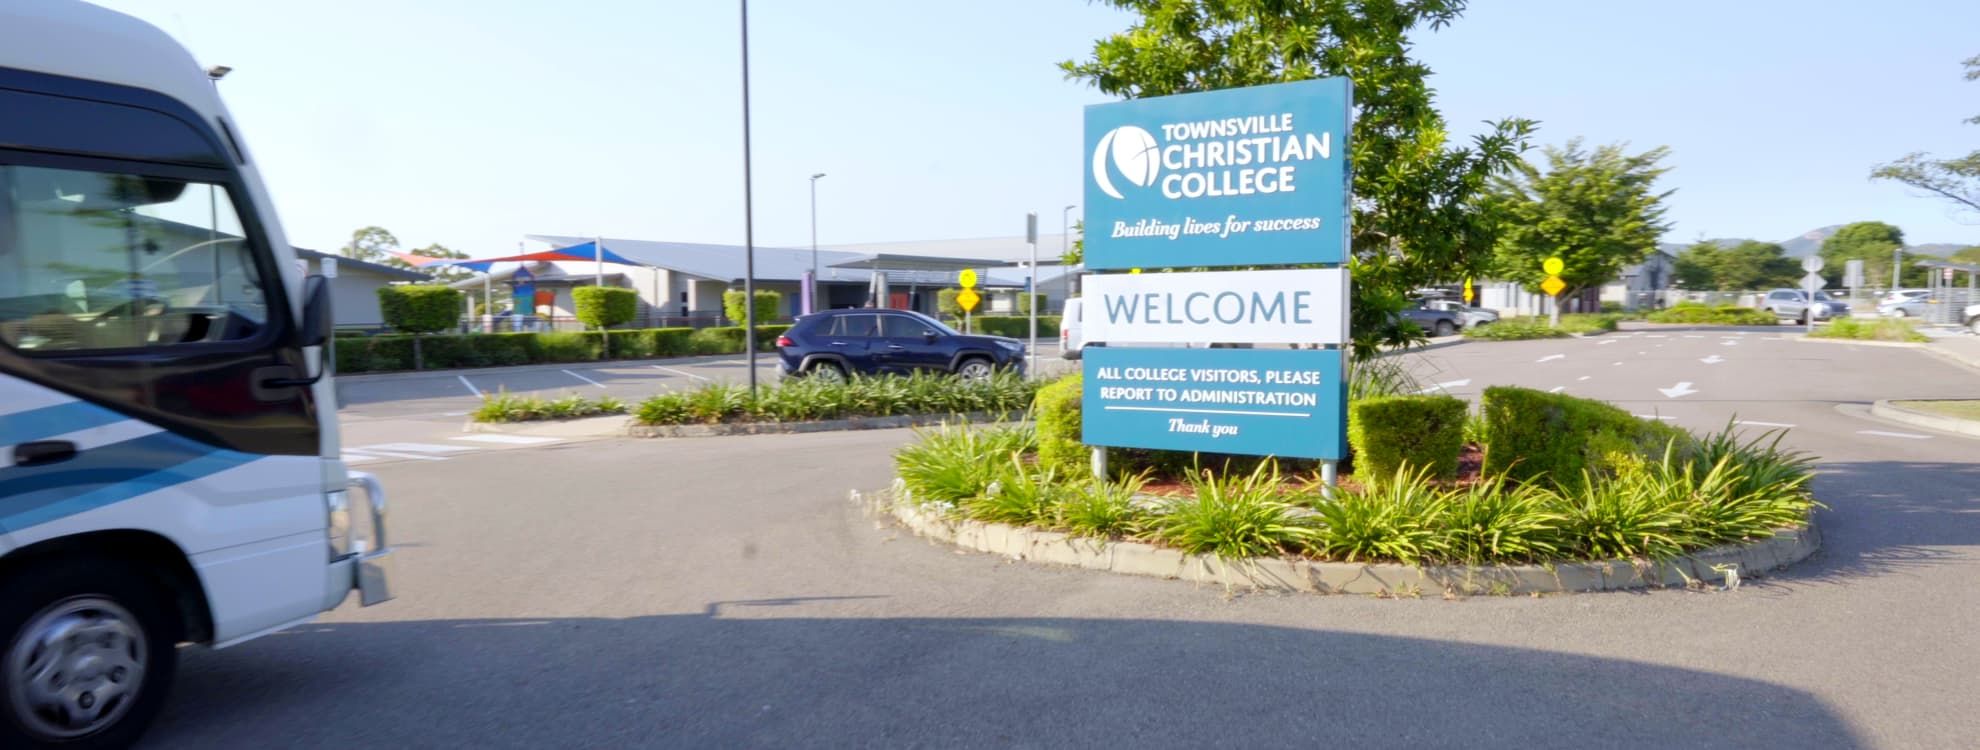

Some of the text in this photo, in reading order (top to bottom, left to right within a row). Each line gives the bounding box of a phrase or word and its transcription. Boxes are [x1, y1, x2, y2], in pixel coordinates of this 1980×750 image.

[1161, 114, 1293, 141] TOWNSVILLE
[1163, 132, 1331, 170] CHRISTIAN
[1162, 166, 1296, 199] COLLEGE
[1111, 215, 1321, 240] Building lives for success
[1104, 291, 1313, 325] WELCOME
[1097, 368, 1321, 385] ALL COLLEGE VISITORS, PLEASE
[1100, 388, 1317, 407] REPORT TO ADMINISTRATION
[1168, 418, 1239, 438] Thank you
